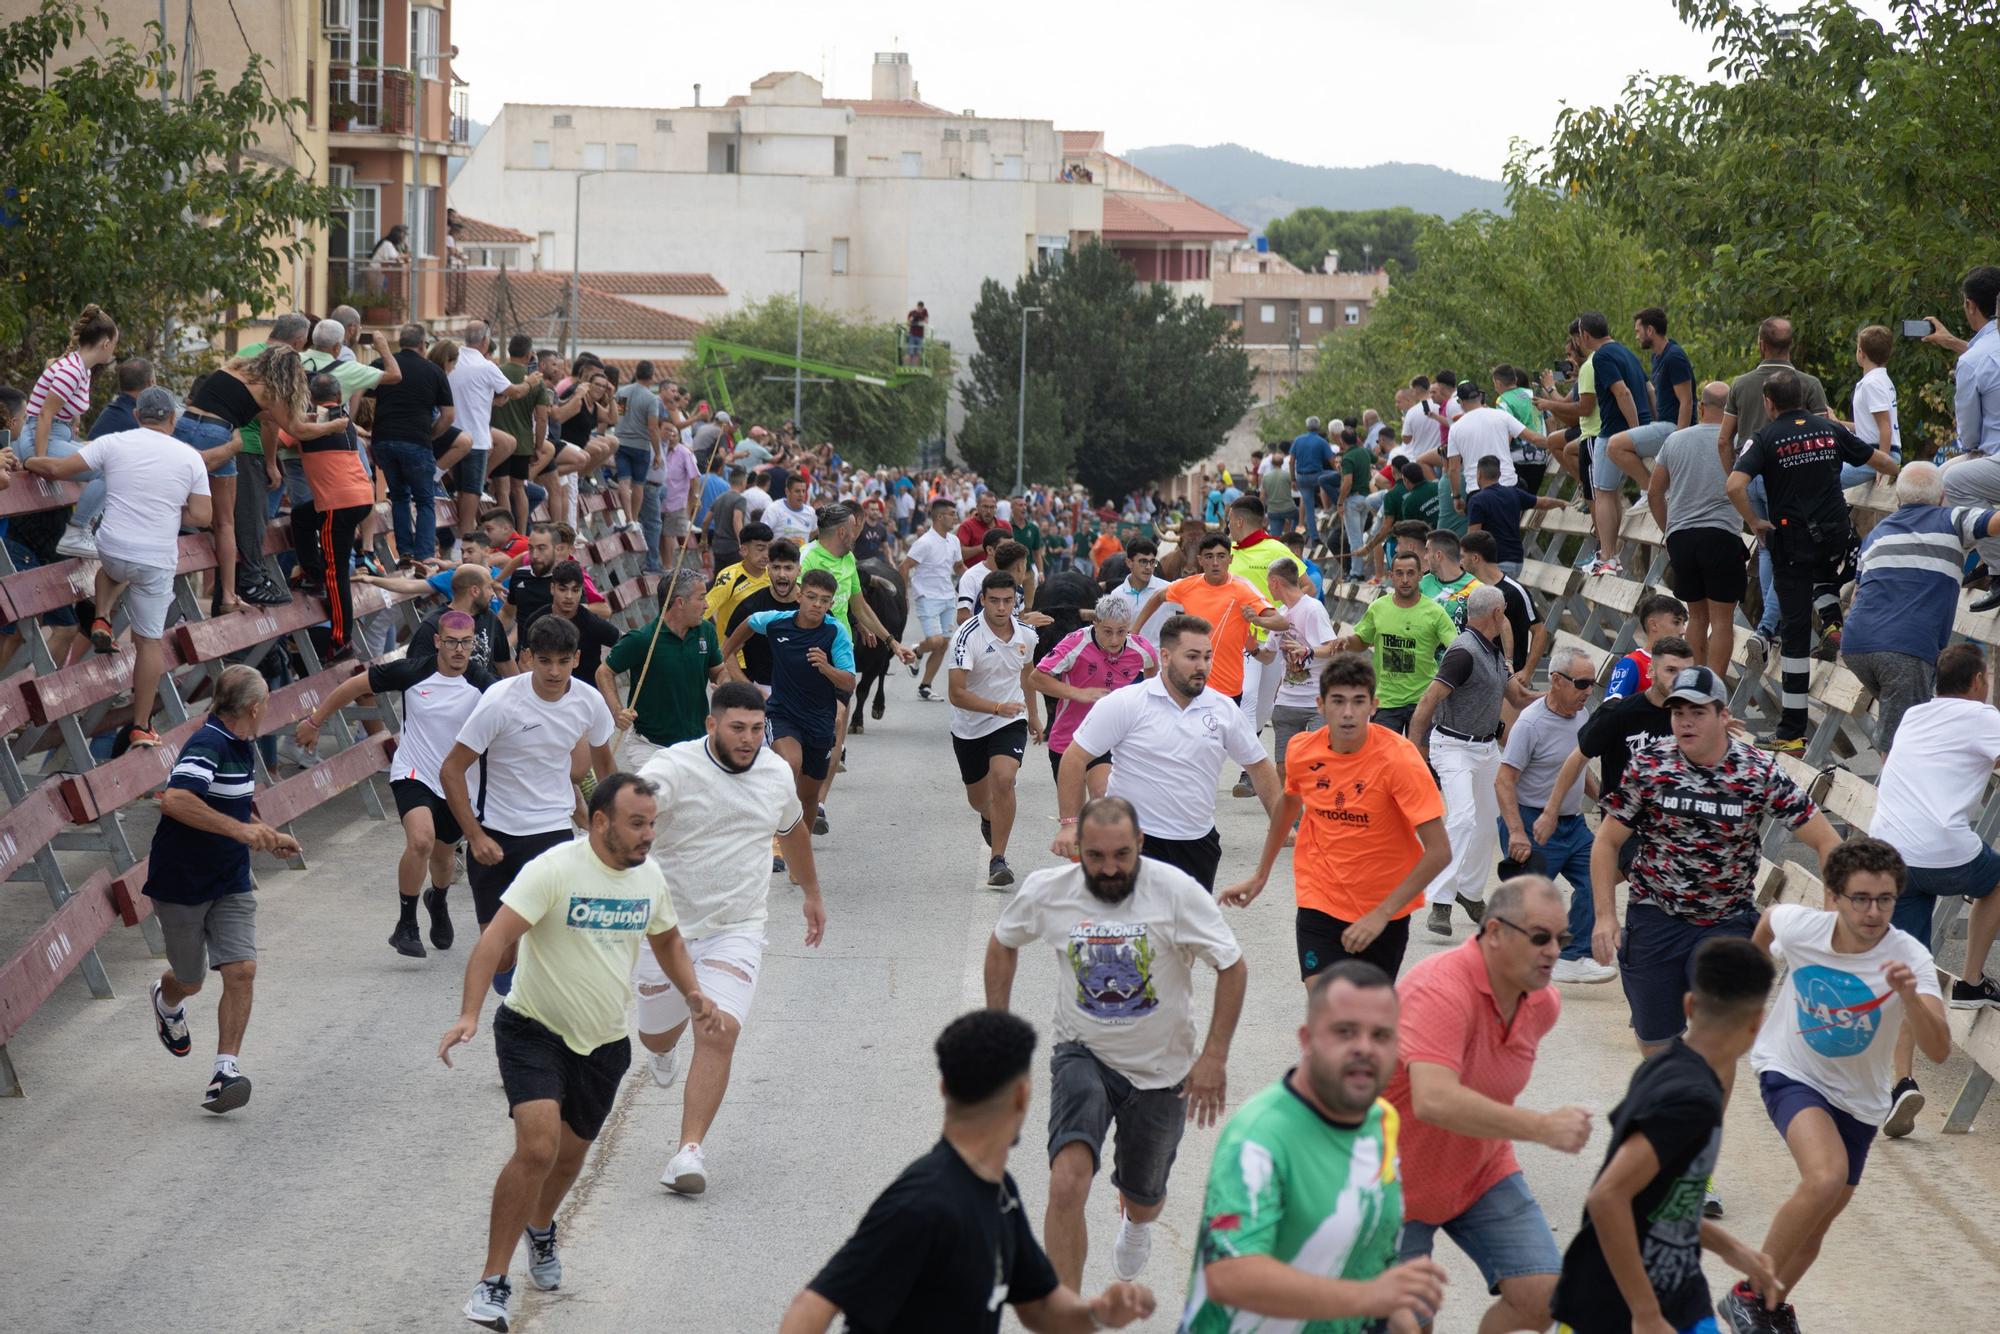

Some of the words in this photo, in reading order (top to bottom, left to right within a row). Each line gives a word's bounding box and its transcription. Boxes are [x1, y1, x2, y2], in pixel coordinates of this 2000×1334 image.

[1777, 442, 1801, 457] 112
[1779, 452, 1817, 464] PROTECCIÓN
[1783, 455, 1834, 468] CALASPARRA
[1681, 797, 1692, 811] IT
[1695, 799, 1717, 815] FOR
[1720, 803, 1742, 817] YOU
[570, 903, 648, 928] Original
[1795, 991, 1874, 1033] NASA
